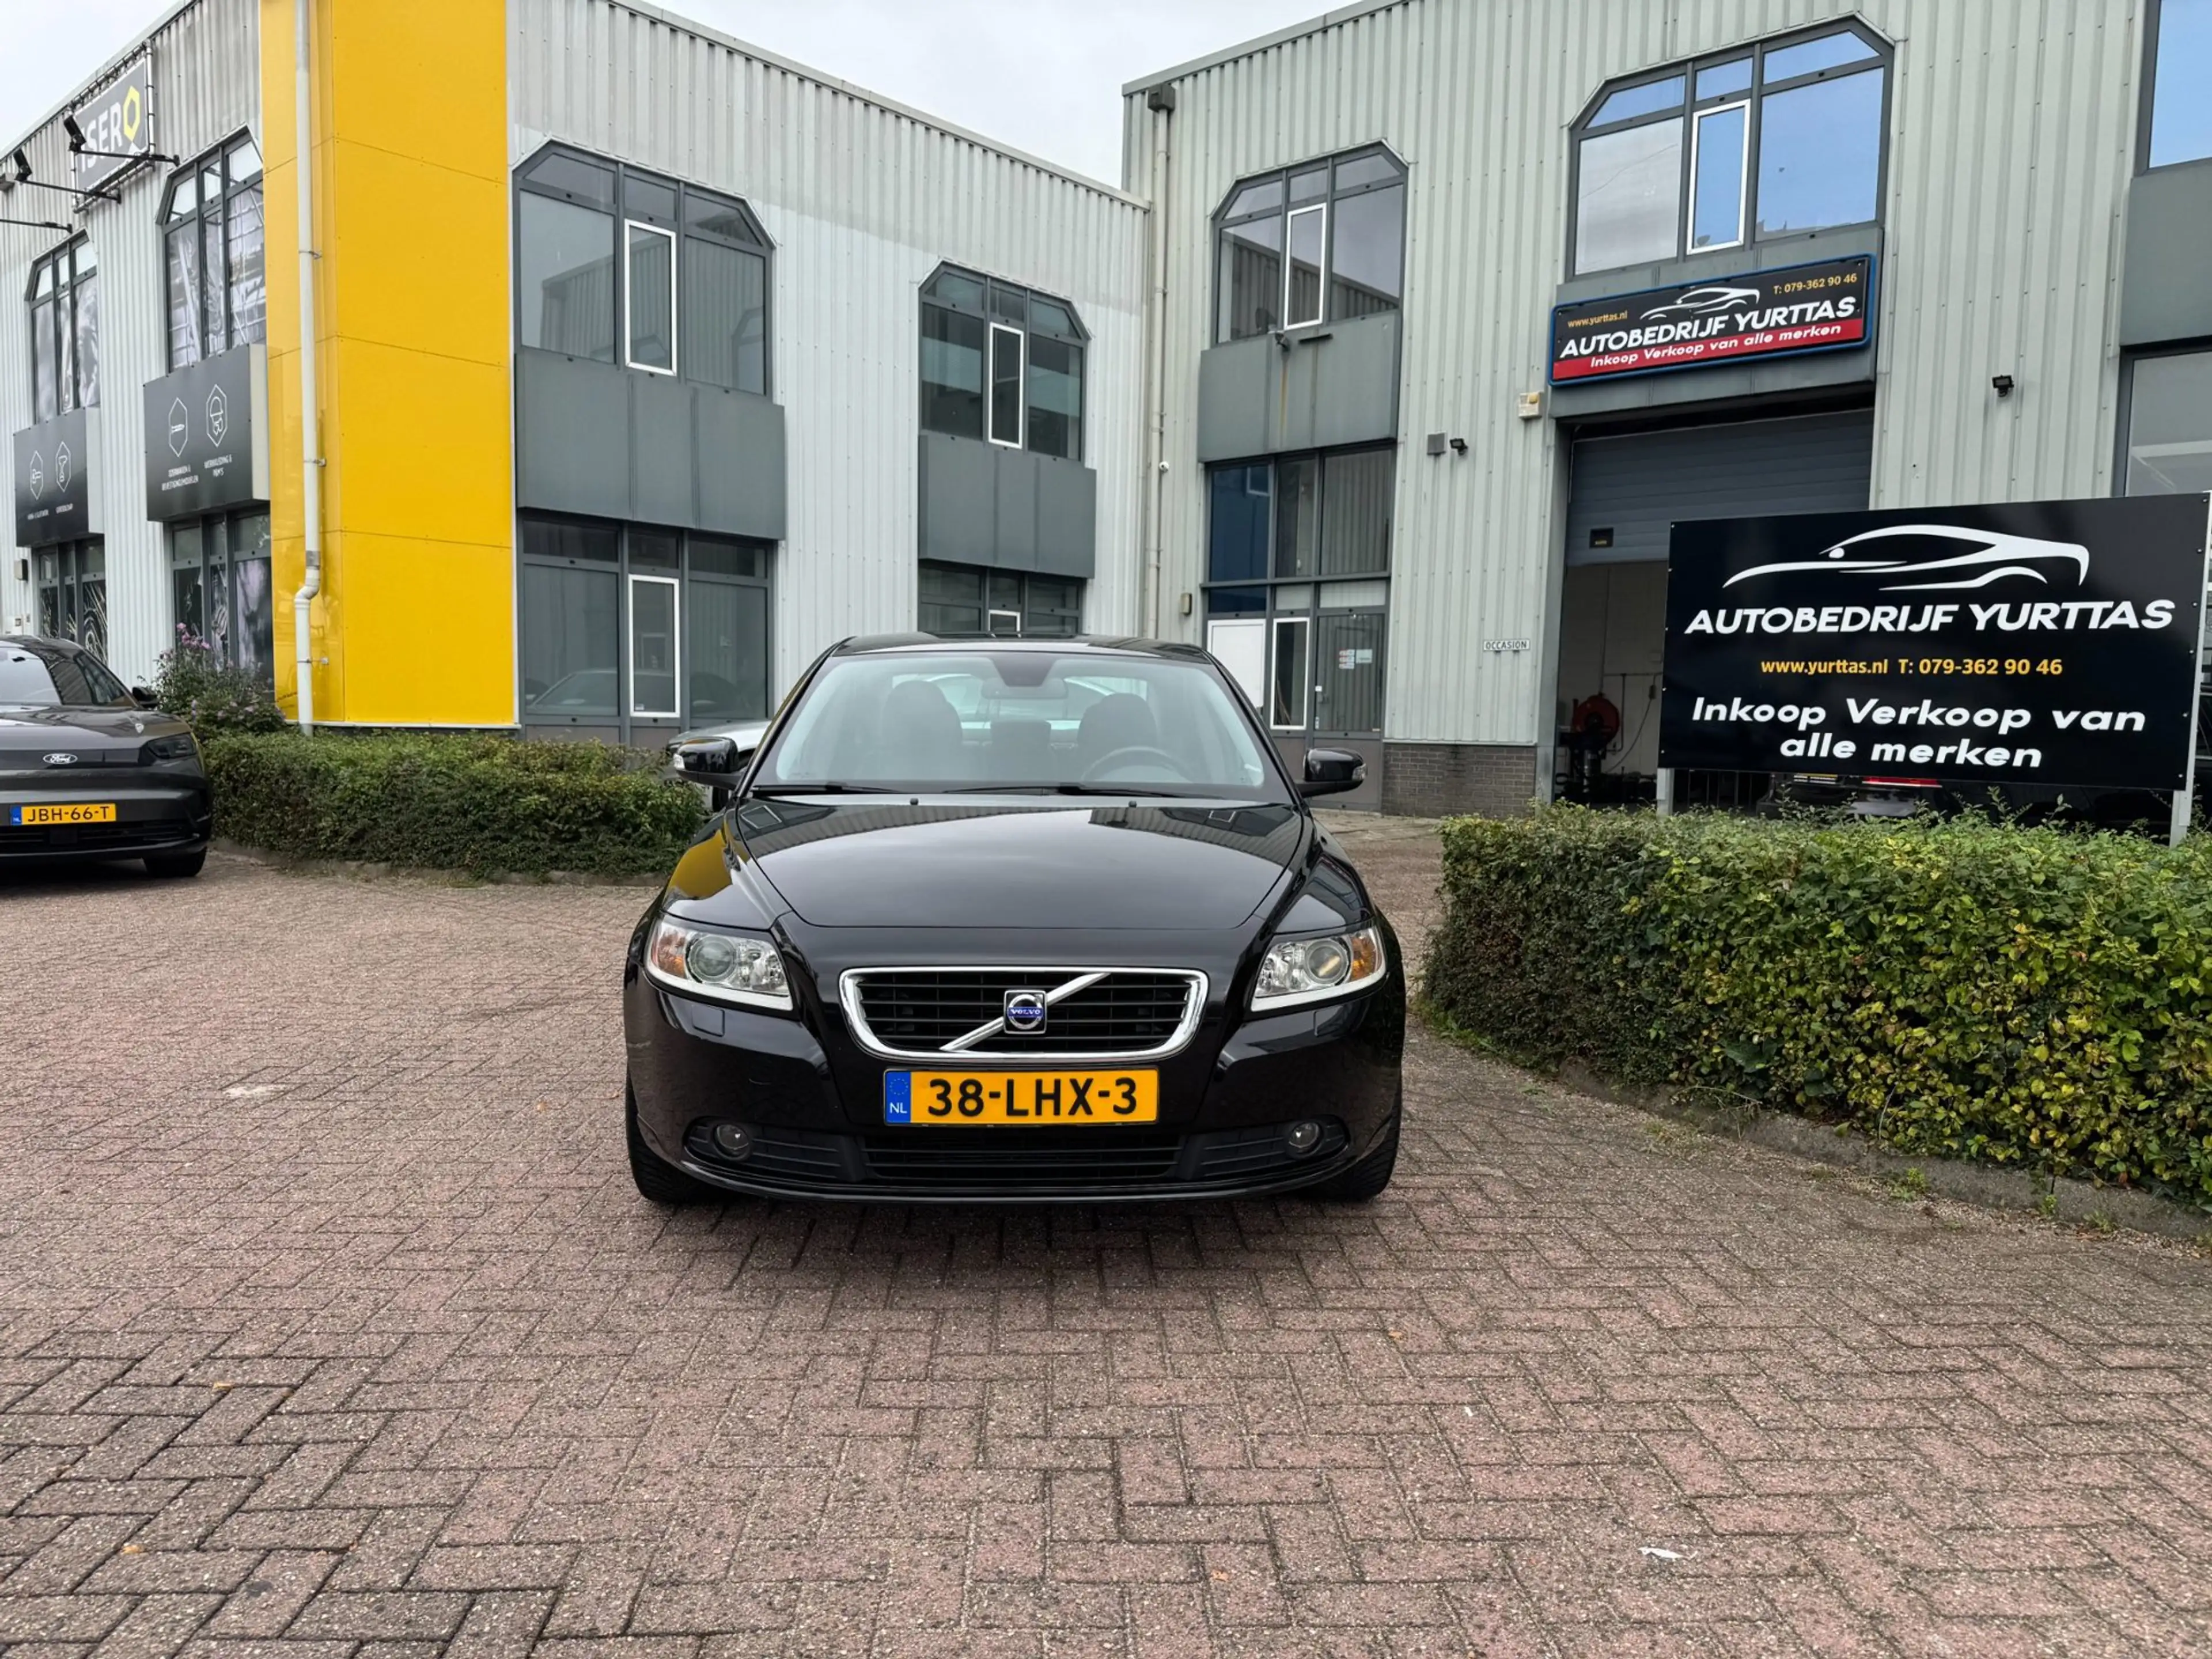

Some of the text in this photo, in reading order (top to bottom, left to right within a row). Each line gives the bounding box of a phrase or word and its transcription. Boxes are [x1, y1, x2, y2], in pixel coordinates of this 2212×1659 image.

[1774, 273, 1857, 294] T: 079-362 90 46
[1559, 296, 1856, 358] AUTOBEDRIJF YURTTAS
[1567, 310, 1627, 328] www.yurttas.nl
[1590, 324, 1842, 368] Inkoop Verkoop van alle merken
[1684, 599, 2176, 634] AUTOBEDRIJF YURTTAS
[1486, 641, 1527, 649] OCCASION
[1761, 658, 2063, 676] www.yurttas.nl T: 079-362 90 46
[1692, 697, 2146, 735] Inkoop Verkoop van
[1780, 732, 2042, 767] alle merken
[28, 806, 109, 822] JBH-66-T
[889, 1077, 1137, 1117] NL 38-LHX-3
